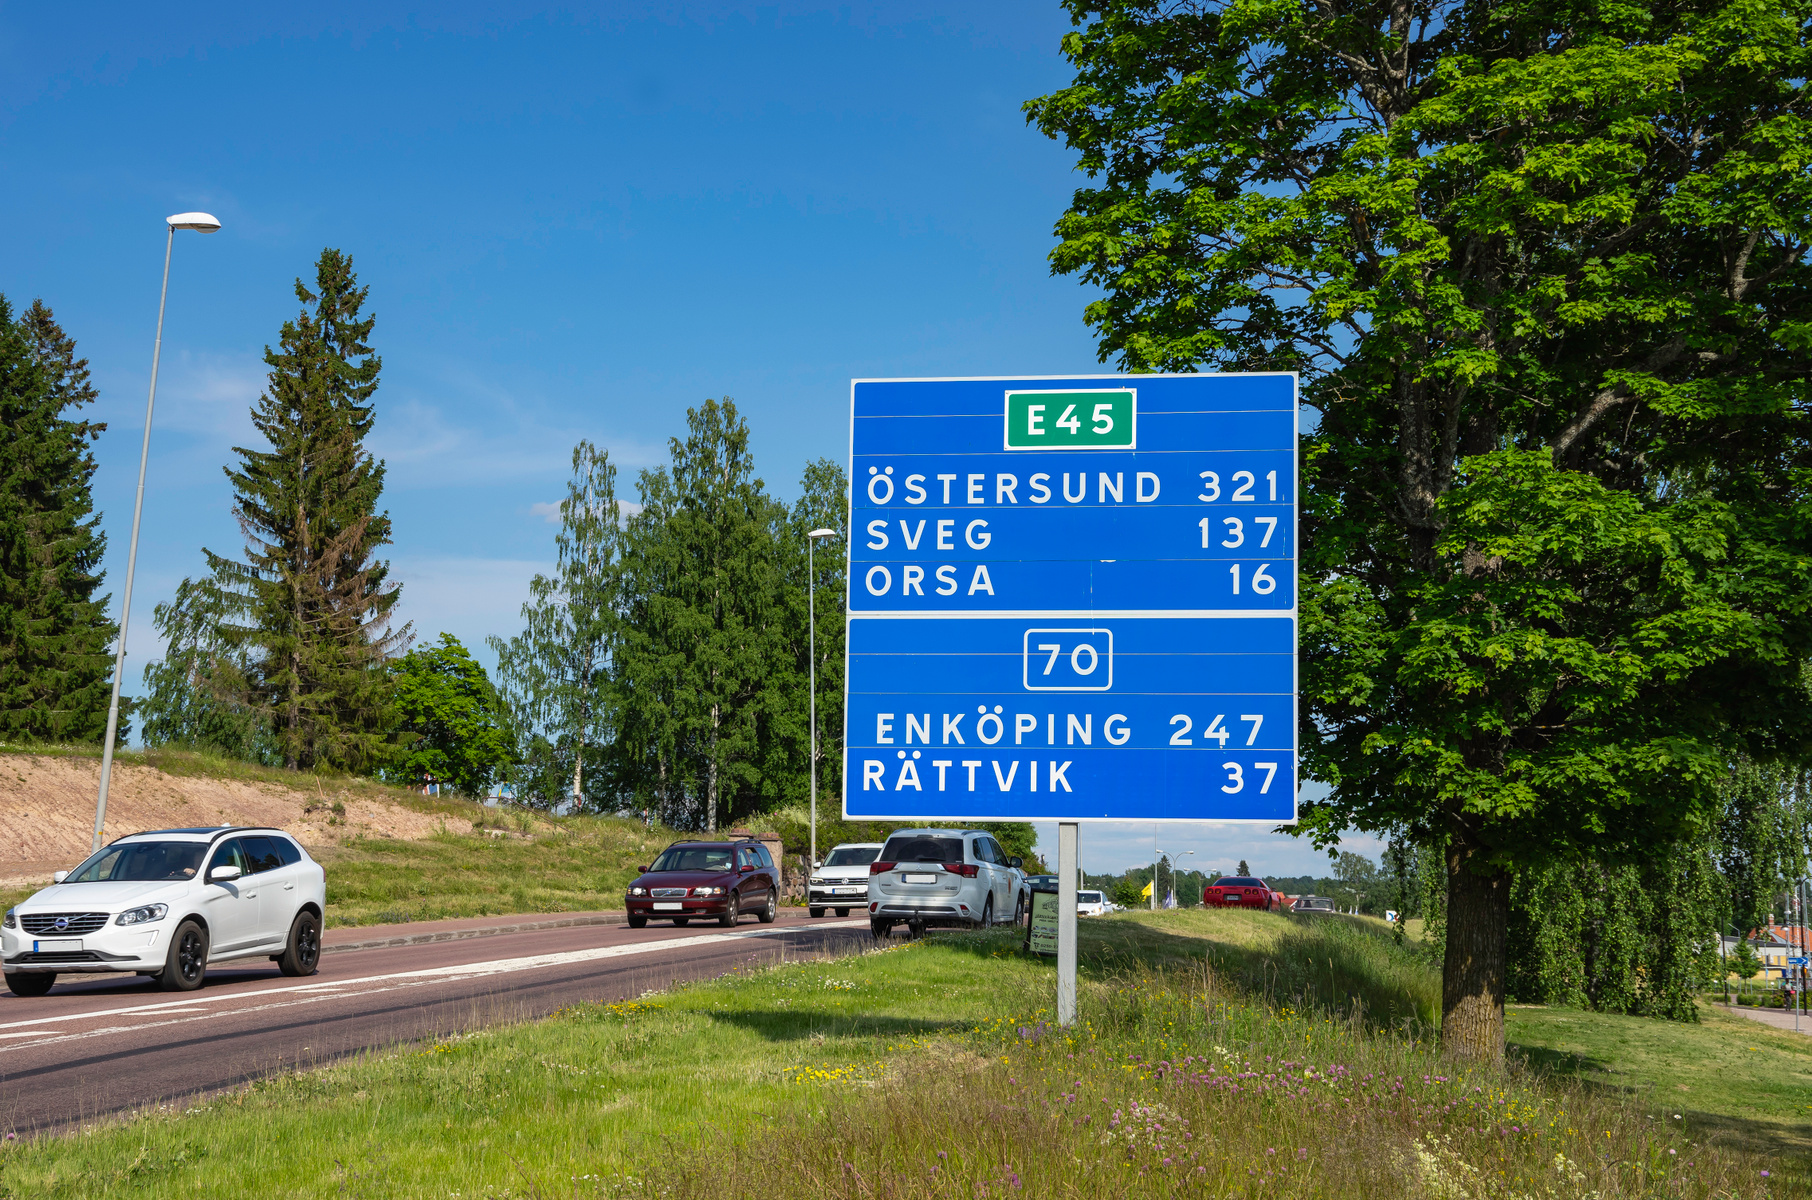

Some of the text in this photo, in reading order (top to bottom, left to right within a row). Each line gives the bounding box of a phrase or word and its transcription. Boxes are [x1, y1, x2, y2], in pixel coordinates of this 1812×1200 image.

[1028, 404, 1114, 436] E45
[868, 466, 1278, 505] ÖSTERSUND 321
[867, 517, 1278, 551] SVEG 137
[866, 564, 1277, 597] ORSA 16
[1039, 644, 1099, 676] 70
[877, 705, 1264, 746] ENKÖPING 247
[864, 751, 1278, 795] RÄTTVIK 37
